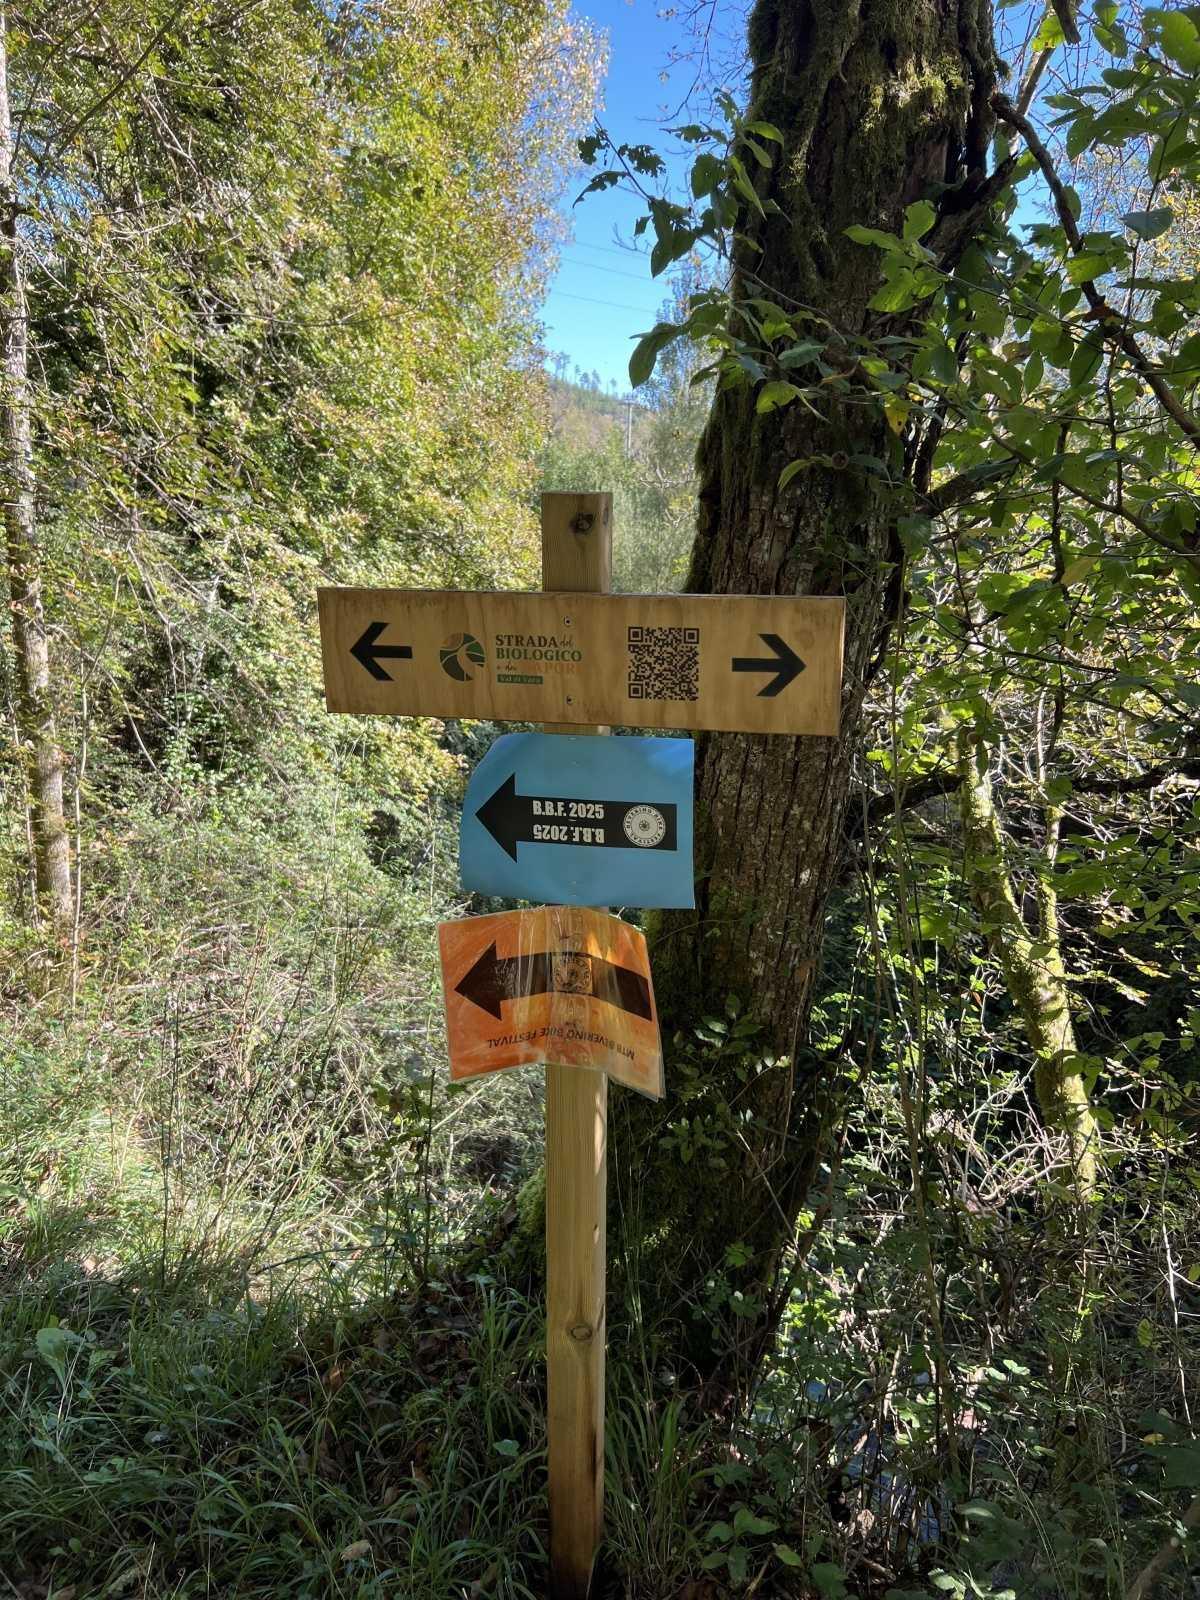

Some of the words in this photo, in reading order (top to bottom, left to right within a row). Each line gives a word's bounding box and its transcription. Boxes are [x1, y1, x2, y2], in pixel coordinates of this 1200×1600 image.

[495, 634, 558, 648] STRADA
[496, 648, 582, 662] BIOLOGICO
[532, 800, 567, 817] B.B.F.
[568, 802, 605, 819] 2025
[533, 825, 566, 841] 2025
[570, 826, 605, 844] B.B.F.
[486, 1030, 537, 1048] FESTIVAL
